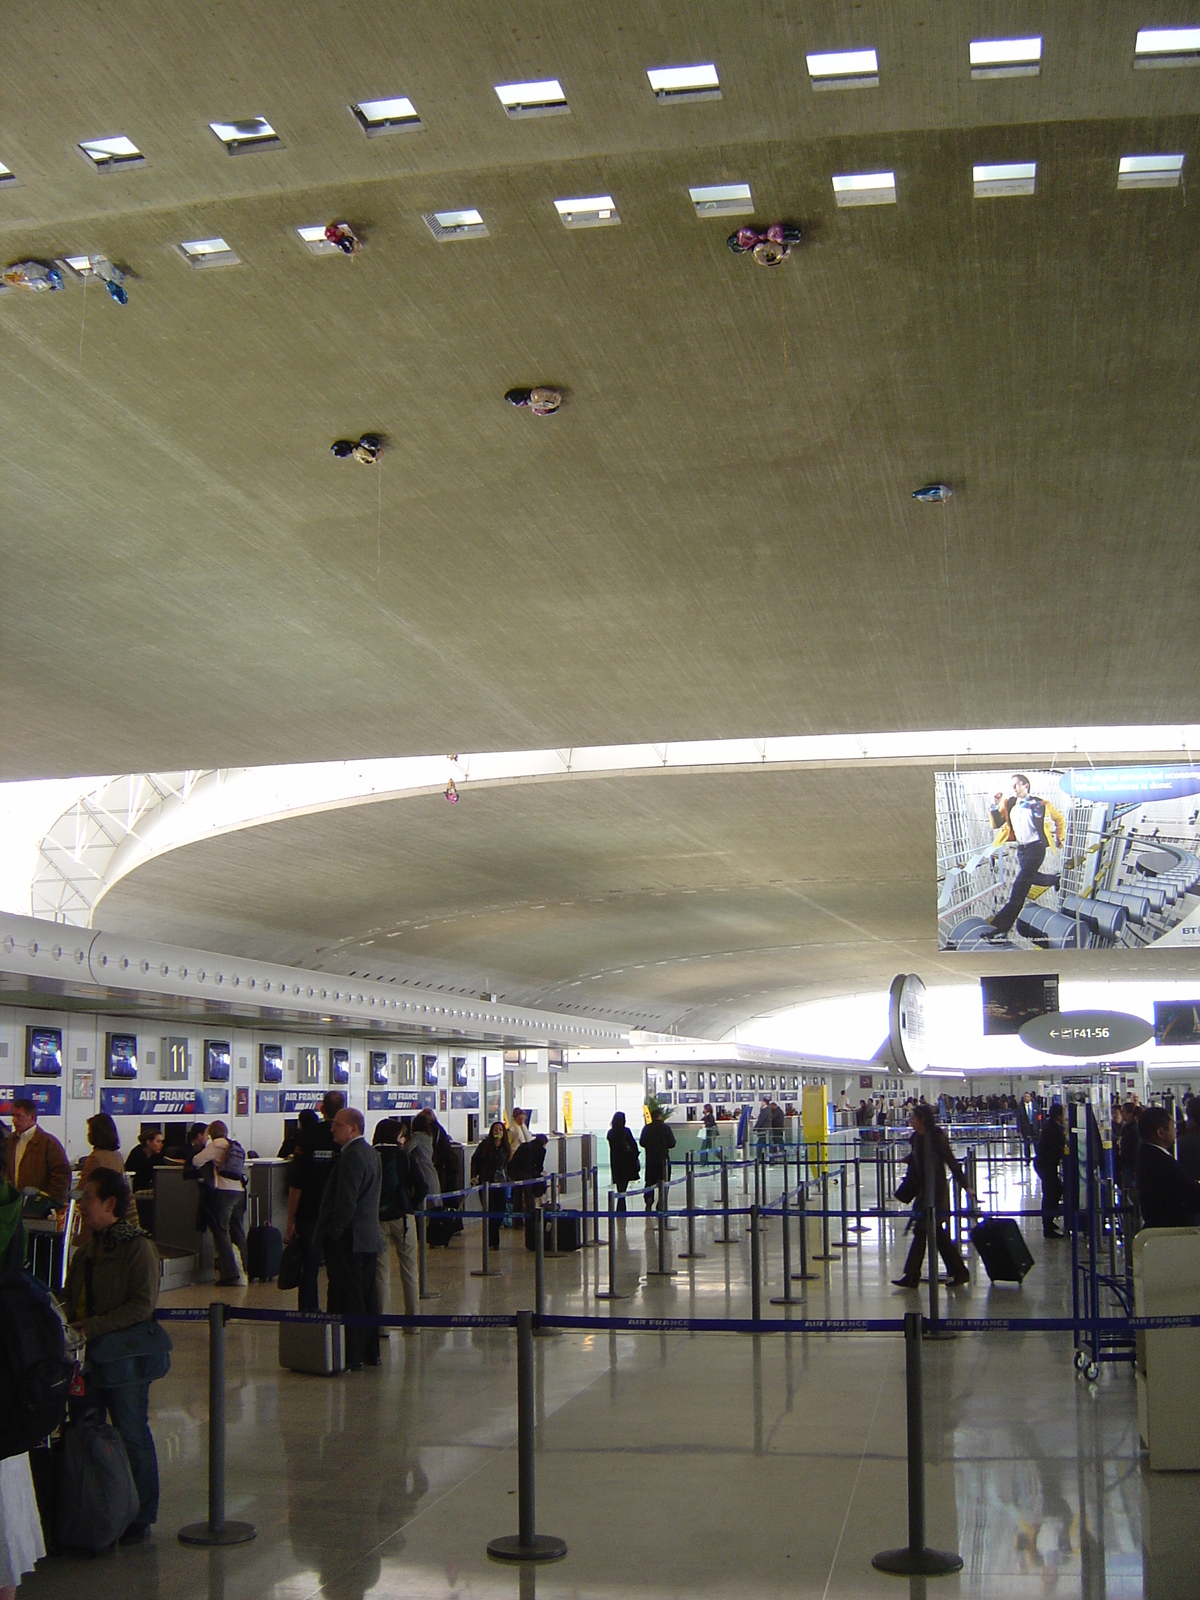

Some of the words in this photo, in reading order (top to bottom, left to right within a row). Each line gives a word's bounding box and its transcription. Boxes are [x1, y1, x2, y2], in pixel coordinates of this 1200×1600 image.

[1182, 927, 1197, 935] BT
[1073, 1027, 1110, 1039] F41-56
[171, 1044, 185, 1073] 11
[306, 1053, 317, 1078] 11
[405, 1059, 414, 1080] 11
[139, 1091, 157, 1101] AIR
[159, 1091, 195, 1101] FRANCE
[285, 1092, 298, 1101] AIR
